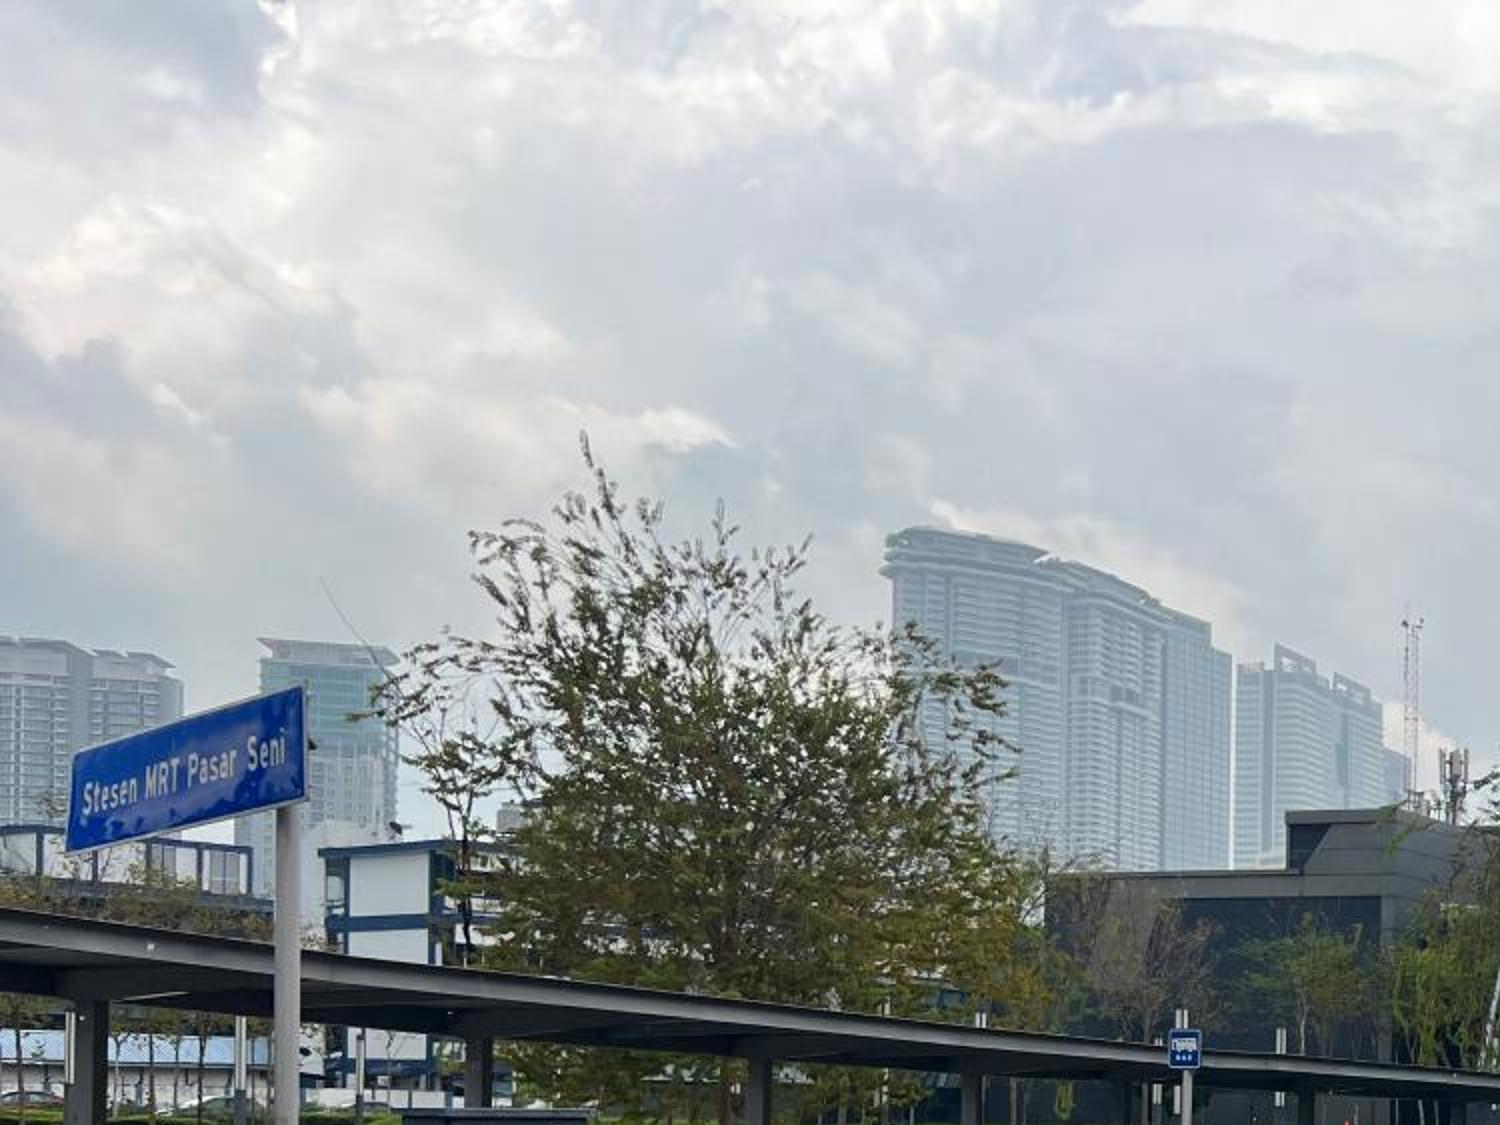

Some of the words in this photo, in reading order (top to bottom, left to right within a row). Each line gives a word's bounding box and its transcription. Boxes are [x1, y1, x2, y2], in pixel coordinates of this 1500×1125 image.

[82, 776, 137, 816] Stesen
[144, 757, 181, 799] MRT
[187, 750, 237, 789] Pasar
[247, 727, 286, 771] Seni
